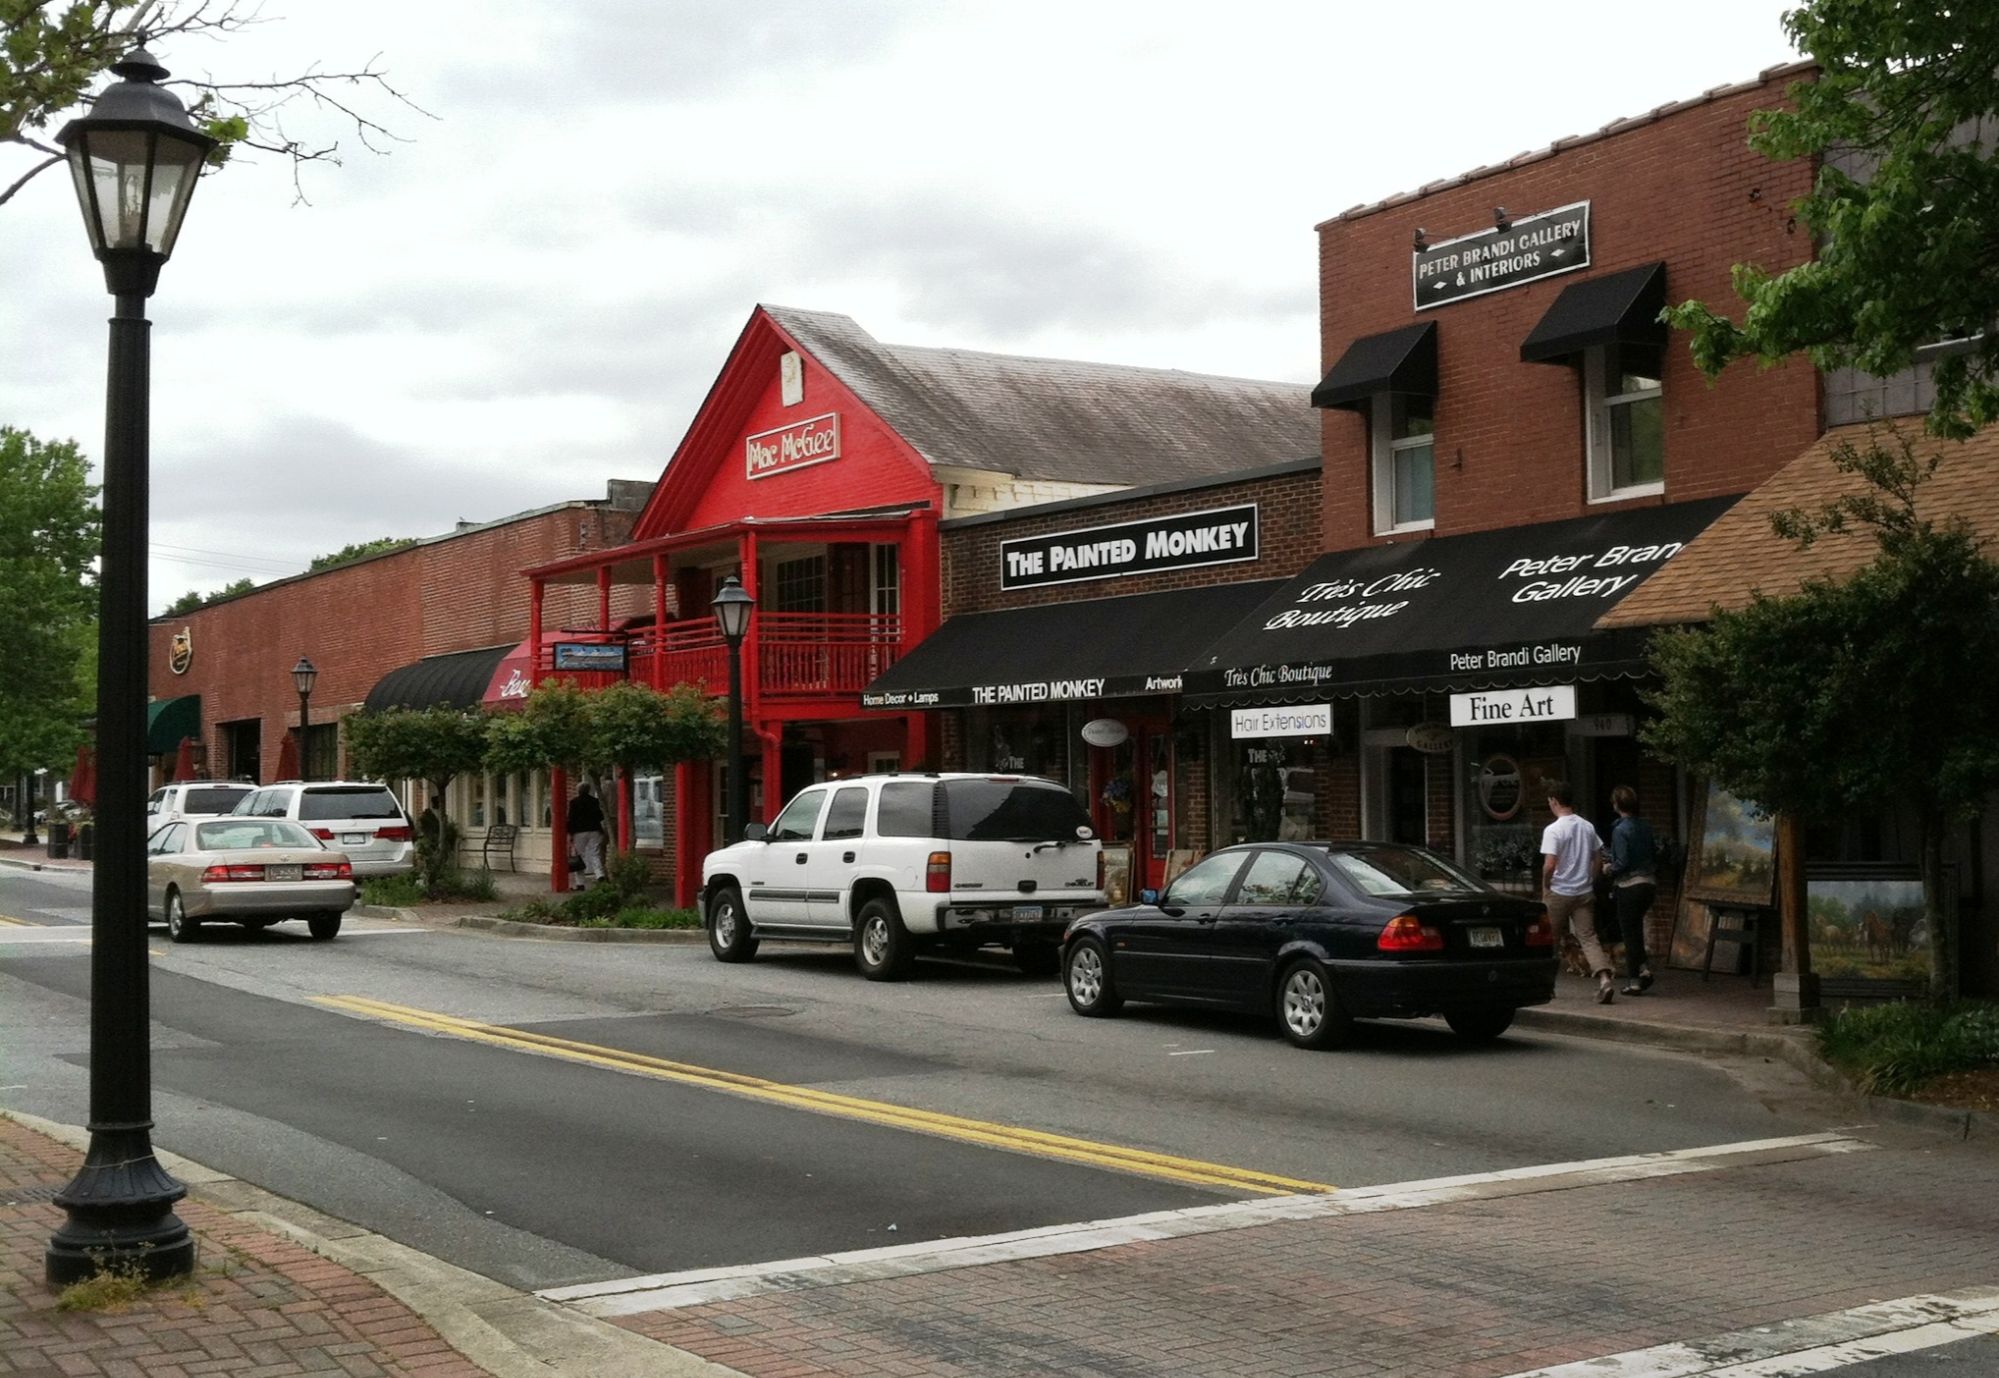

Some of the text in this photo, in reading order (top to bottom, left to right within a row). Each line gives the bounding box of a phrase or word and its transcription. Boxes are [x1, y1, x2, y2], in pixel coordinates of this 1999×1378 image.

[1419, 219, 1581, 279] PETER BRANDI GALLERY
[1456, 251, 1541, 287] & INTERIORS
[749, 423, 834, 471] Mac McGee
[1007, 522, 1248, 577] THE PAINTED MONKEY
[1498, 553, 1593, 580] Peter
[1361, 567, 1442, 598] Chic
[1511, 574, 1637, 604] Gallery
[1263, 600, 1410, 630] Boutique
[1450, 644, 1581, 671] Peter Brandi Gallery
[1251, 664, 1276, 686] Chic
[1278, 662, 1333, 686] Boutique
[863, 691, 939, 706] Home Decor Lamps
[972, 678, 1105, 704] THE PAINTED MONKEY
[1469, 694, 1554, 721] Fine Art
[1235, 711, 1327, 733] Hair Extensions
[1009, 756, 1025, 769] THE
[1248, 748, 1267, 763] THE
